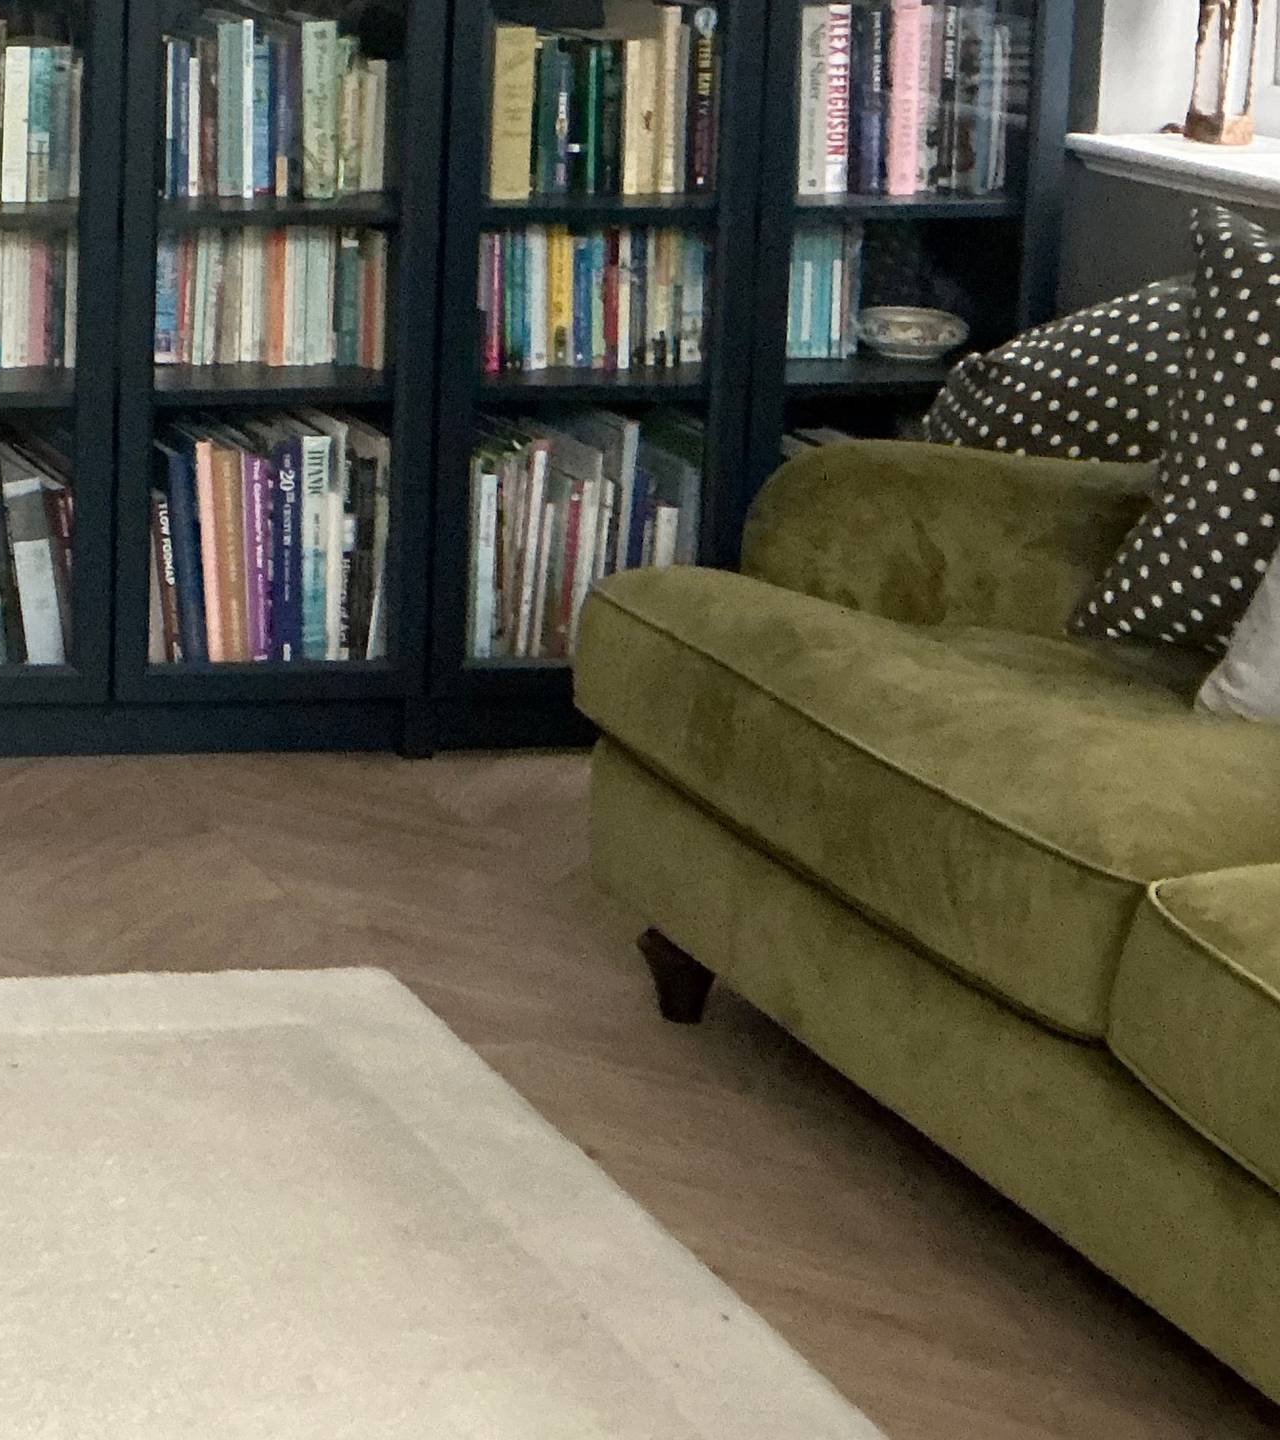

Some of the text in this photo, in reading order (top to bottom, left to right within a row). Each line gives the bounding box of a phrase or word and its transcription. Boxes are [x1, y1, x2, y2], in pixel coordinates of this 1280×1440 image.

[808, 23, 825, 58] Nigel
[811, 61, 826, 100] Slater
[827, 11, 849, 156] ALEX FERGUSON
[901, 99, 912, 158] EXPRESS
[307, 450, 325, 497] TITANIC
[158, 510, 170, 535] LOW
[162, 538, 175, 586] FODMAP
